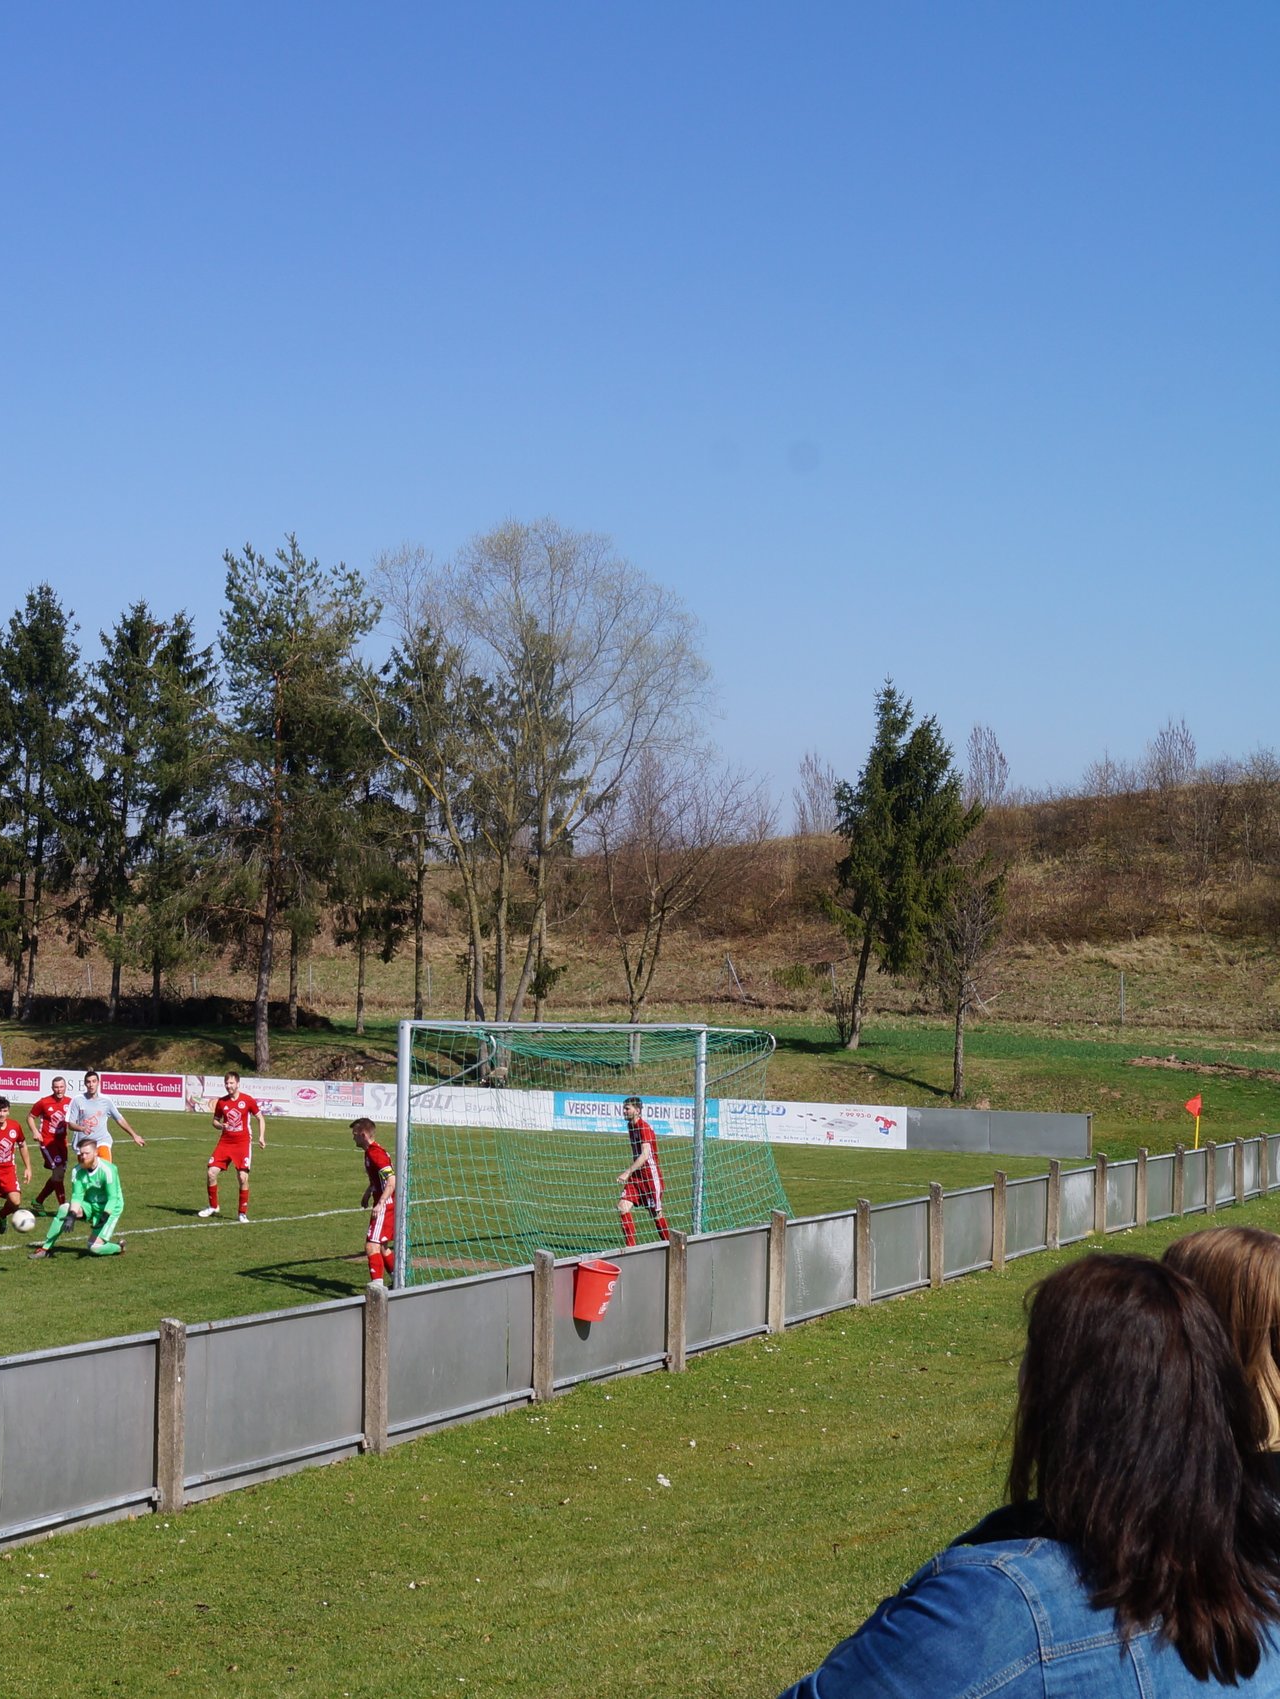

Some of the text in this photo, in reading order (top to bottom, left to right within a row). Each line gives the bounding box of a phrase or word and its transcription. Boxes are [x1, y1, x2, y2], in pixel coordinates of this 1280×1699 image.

[16, 1078, 39, 1087] GmbH
[102, 1081, 181, 1093] Elektrotechnik GmbH
[569, 1102, 611, 1115] VERSPIEL
[647, 1107, 671, 1118] DEIN
